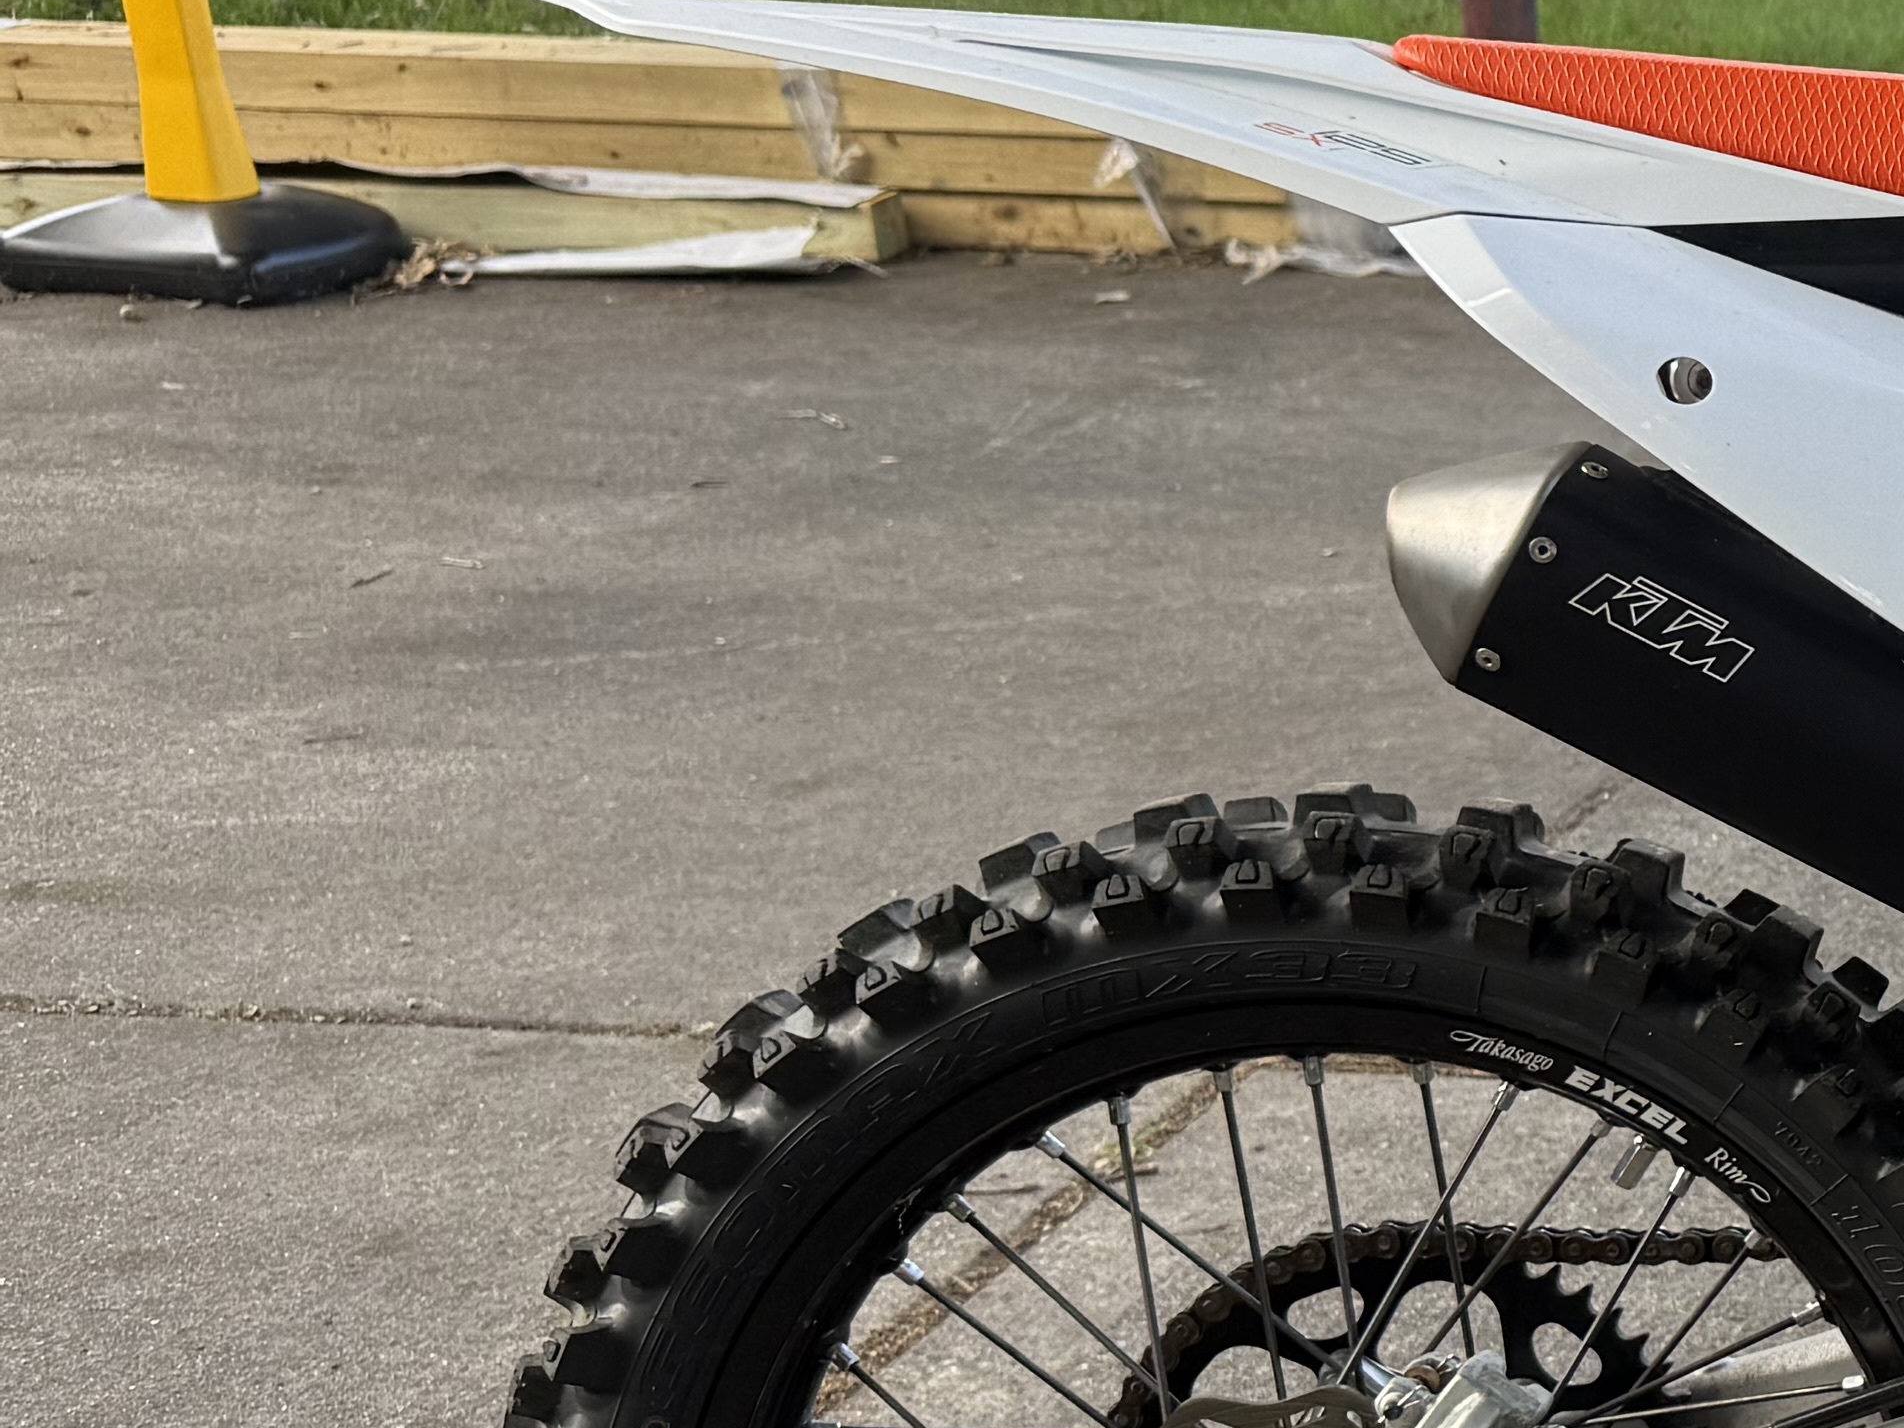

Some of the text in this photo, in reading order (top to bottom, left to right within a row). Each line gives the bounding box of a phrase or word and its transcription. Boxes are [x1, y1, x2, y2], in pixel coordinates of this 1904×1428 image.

[1567, 572, 1757, 684] KTM
[1449, 1028, 1555, 1073] Takasago
[1562, 1065, 1692, 1146] EXCEL
